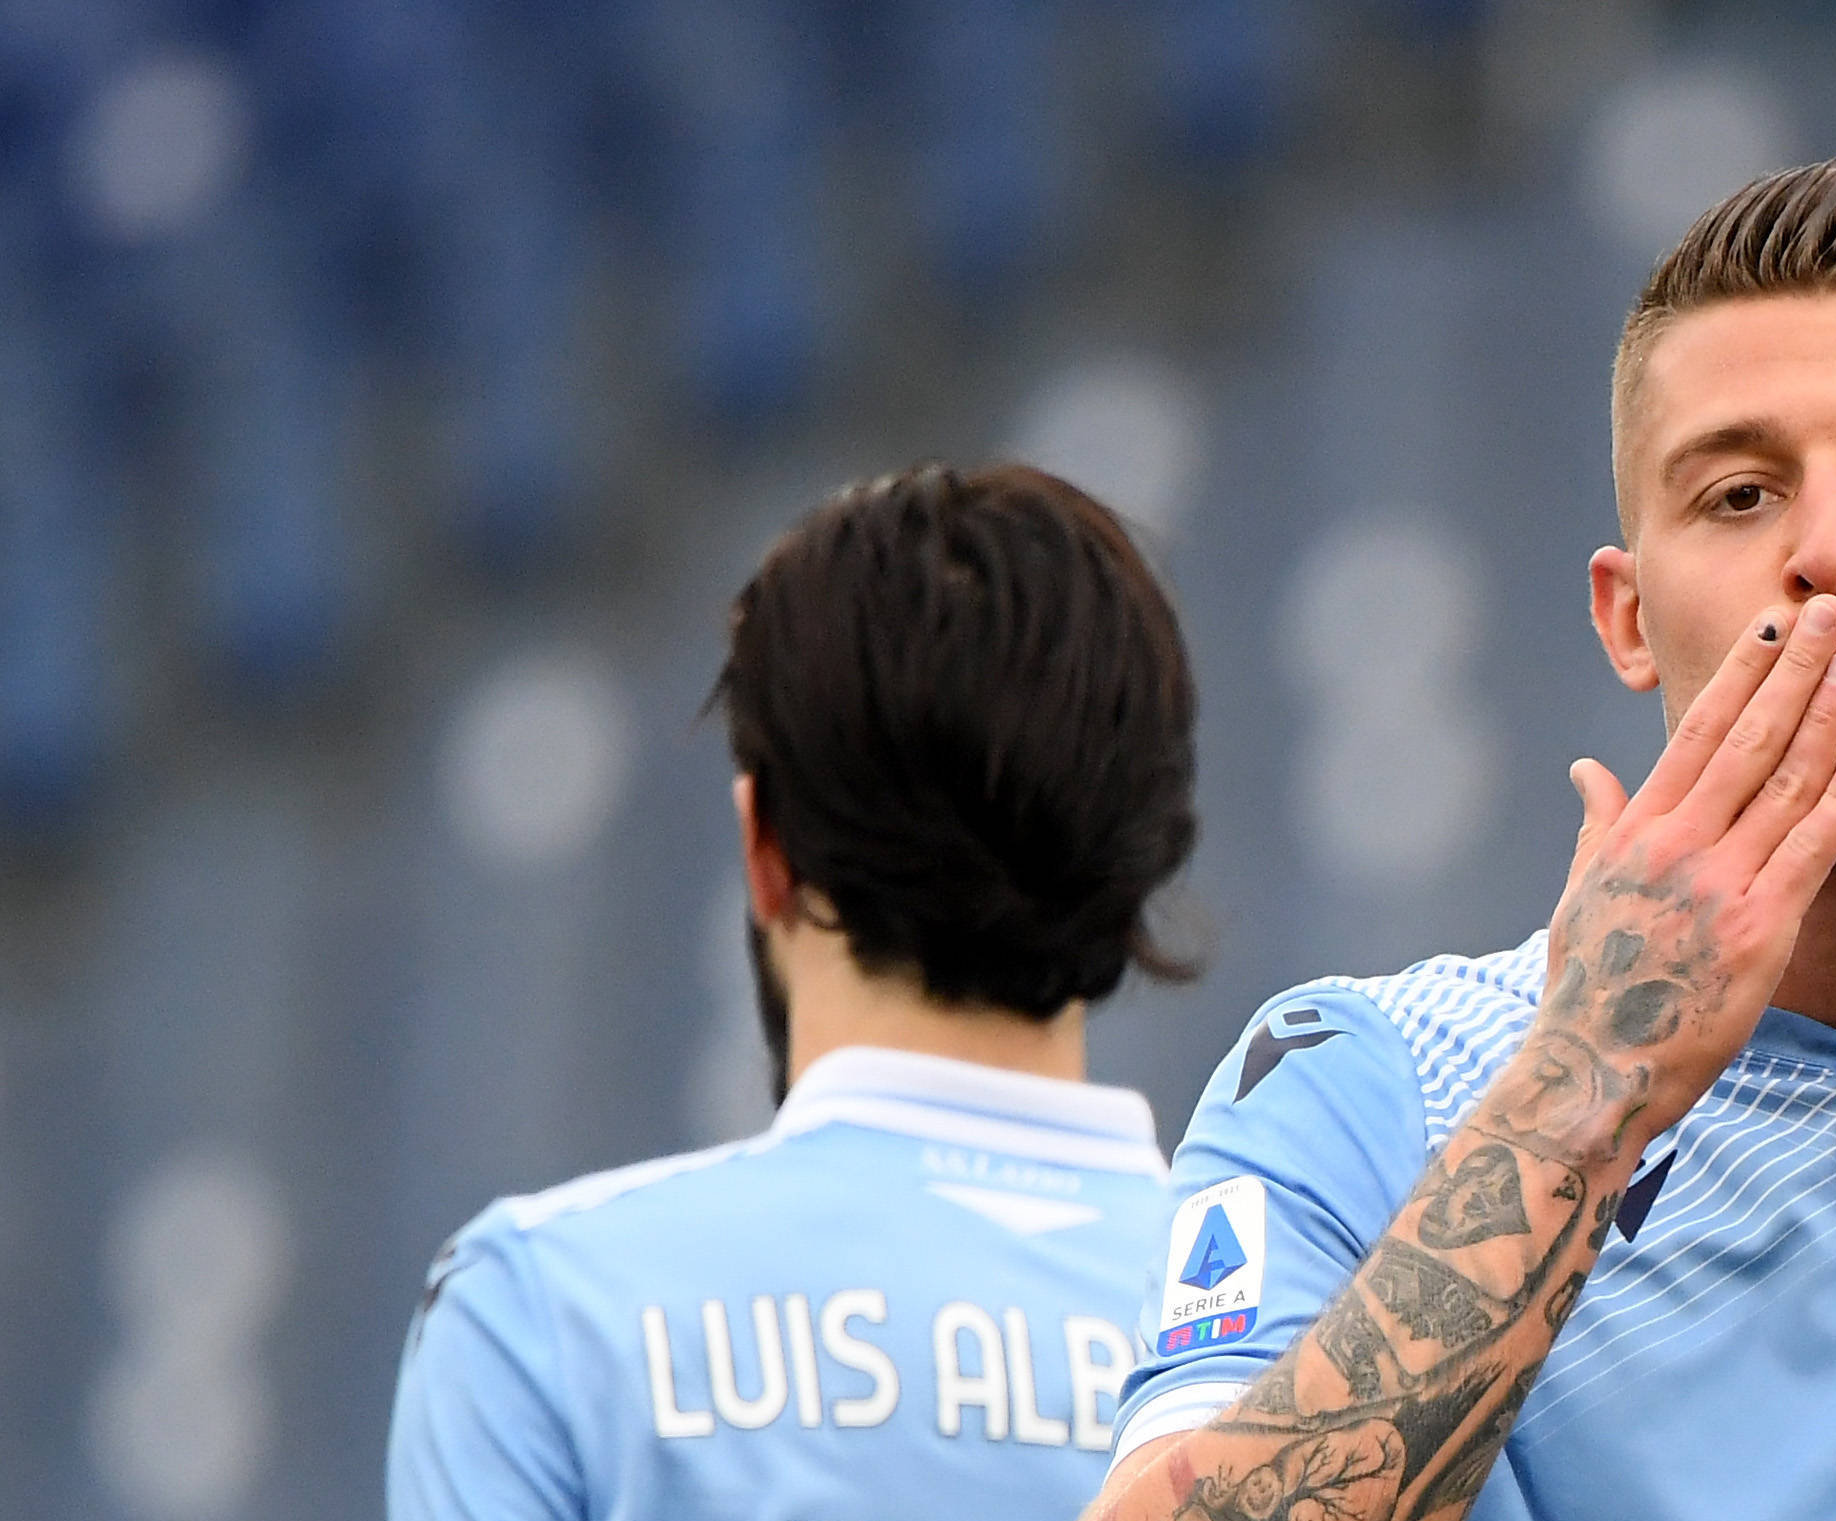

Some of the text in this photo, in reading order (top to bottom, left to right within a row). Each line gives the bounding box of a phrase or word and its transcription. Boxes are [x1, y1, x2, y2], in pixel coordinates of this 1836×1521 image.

[1172, 1289, 1246, 1321] SERIE A
[1197, 1314, 1246, 1341] TIM
[641, 1289, 1137, 1452] LUIS ALB
